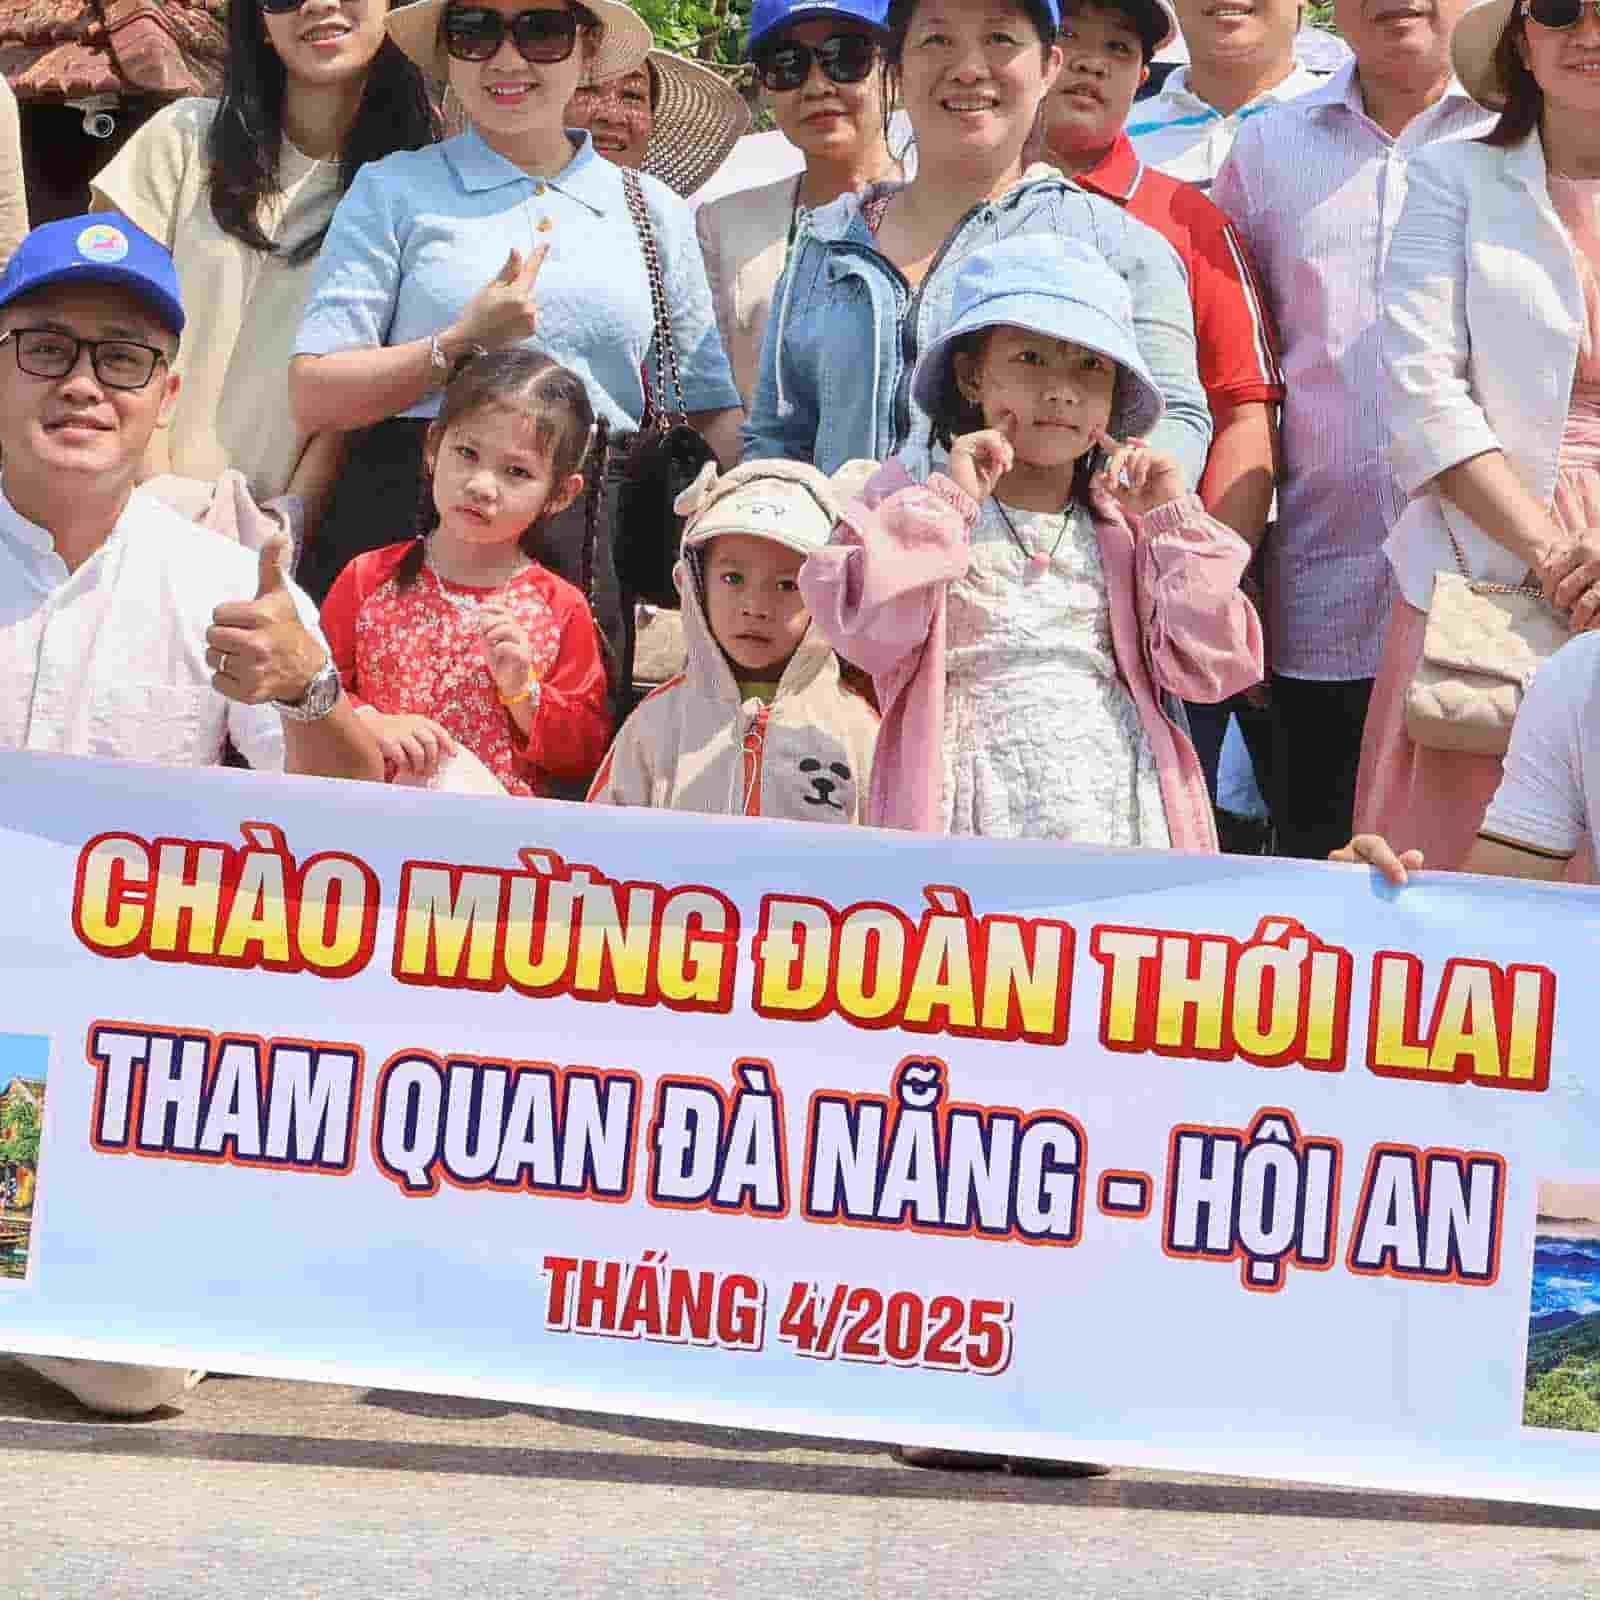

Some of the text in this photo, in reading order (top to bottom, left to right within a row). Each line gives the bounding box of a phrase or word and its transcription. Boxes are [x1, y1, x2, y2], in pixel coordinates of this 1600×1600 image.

[71, 821, 1556, 1092] CHÀO MỪNG ĐOÀN THỚI LAI
[87, 1019, 1508, 1292] THAM QUAN ĐÀ NẴNG - HỘI AN
[540, 1247, 1013, 1376] THÁNG 4/2025
